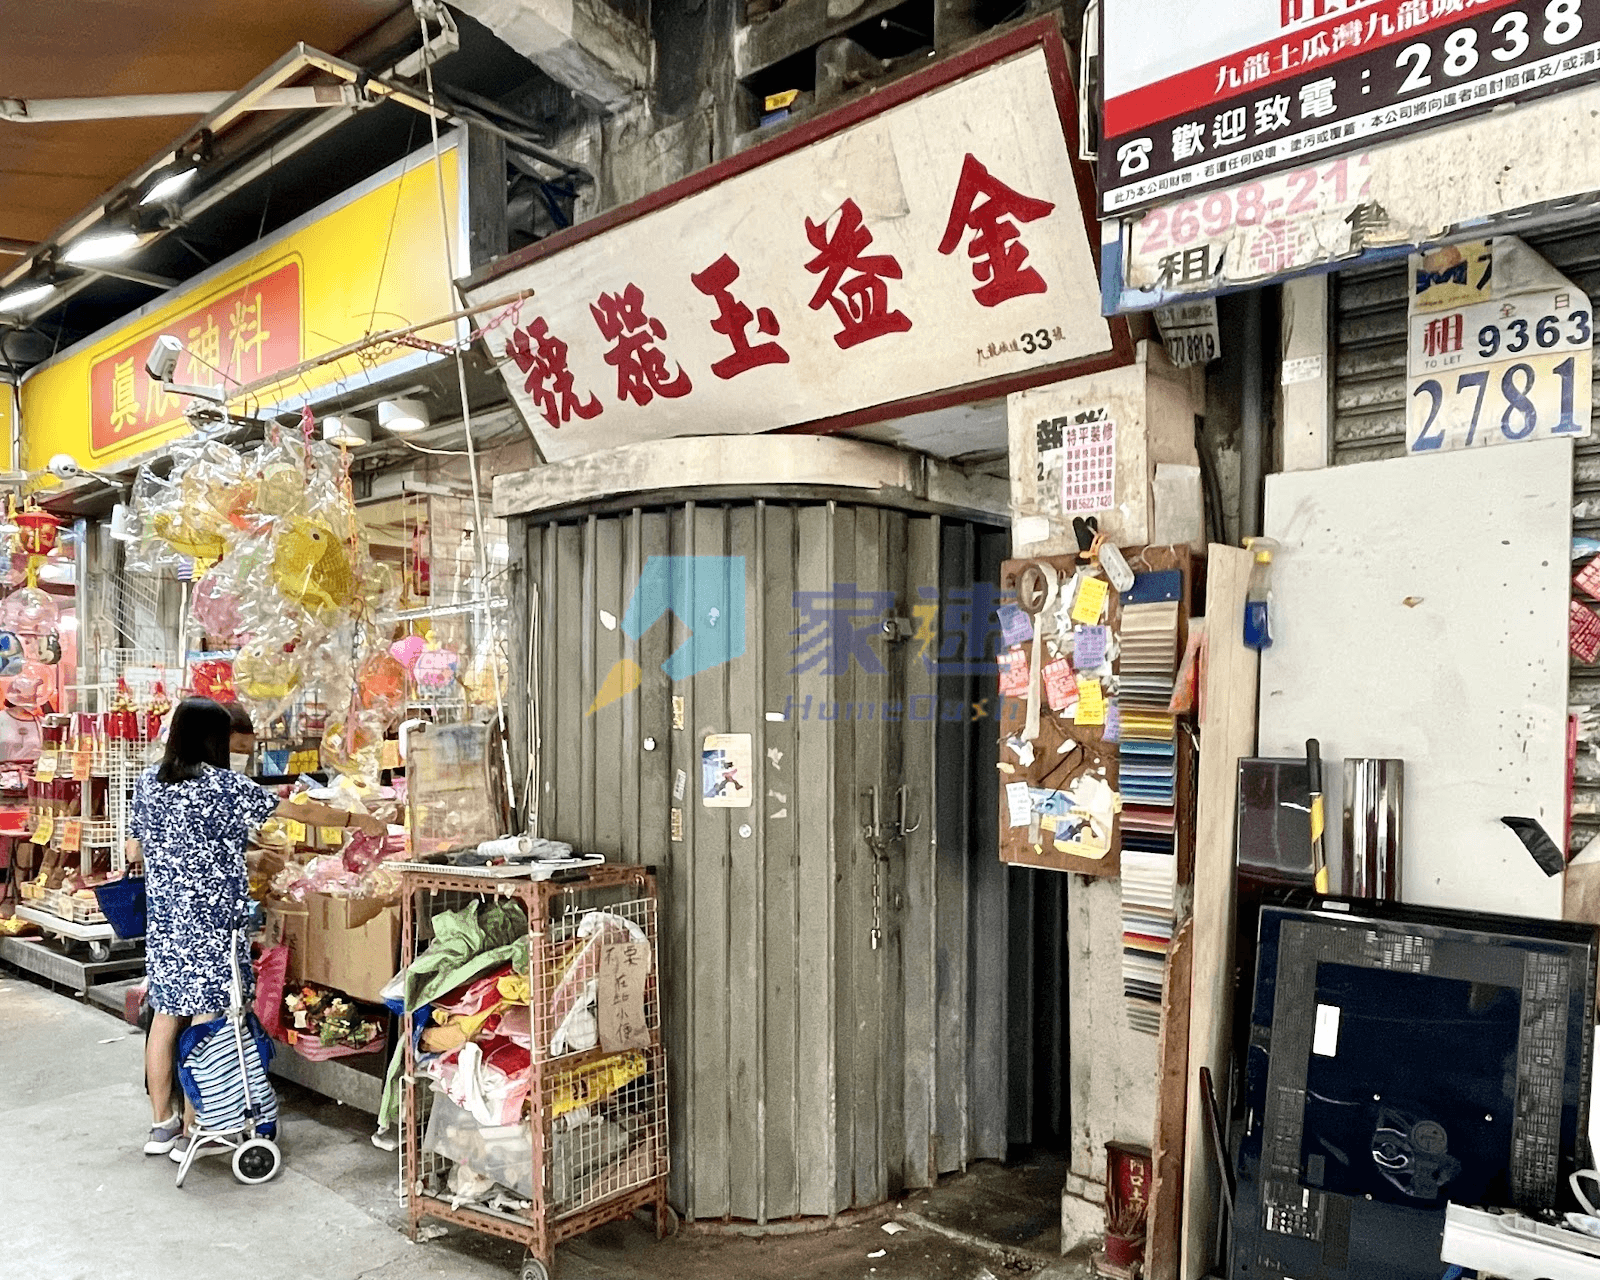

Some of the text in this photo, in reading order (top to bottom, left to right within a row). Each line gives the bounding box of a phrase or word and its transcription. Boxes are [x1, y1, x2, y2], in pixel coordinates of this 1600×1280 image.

[1395, 0, 1583, 95] 2838
[1424, 313, 1464, 357] 租
[1478, 310, 1591, 358] 9363
[1425, 354, 1461, 369] TO LET
[1411, 356, 1582, 452] 2781
